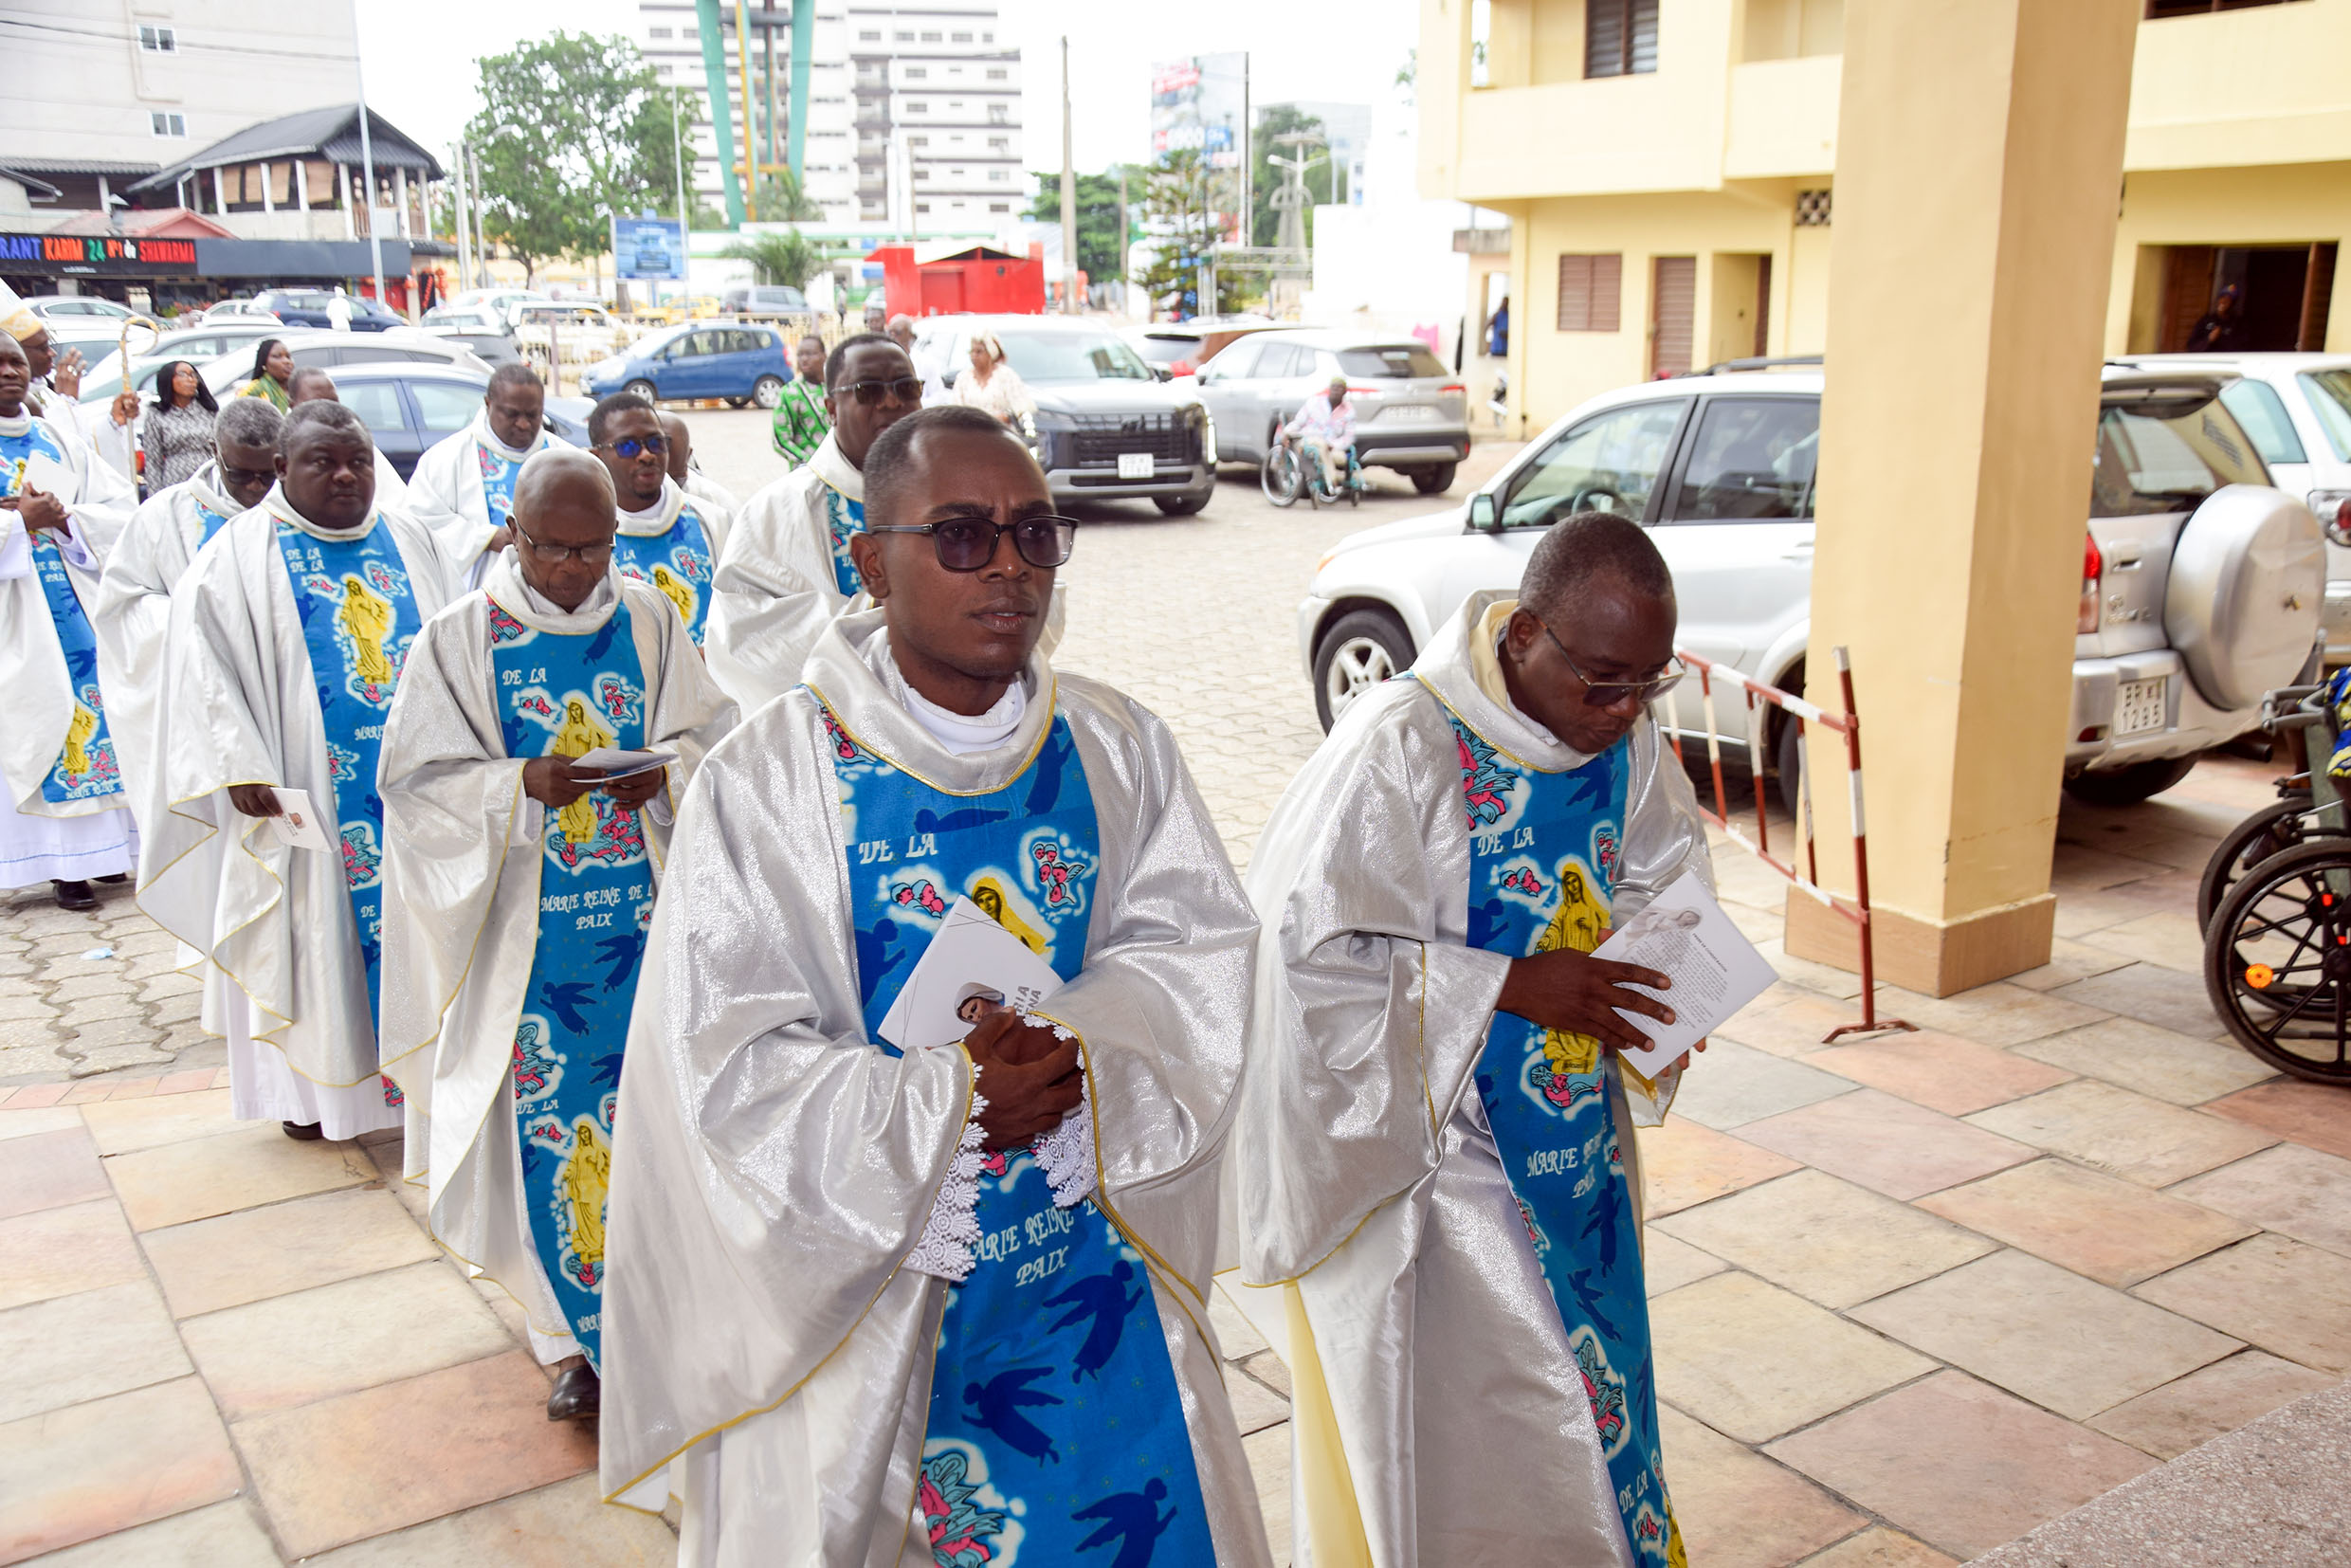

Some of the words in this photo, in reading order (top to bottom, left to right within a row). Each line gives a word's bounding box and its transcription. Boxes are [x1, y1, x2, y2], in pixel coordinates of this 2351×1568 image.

[0, 236, 41, 261] RANT
[44, 236, 84, 262] KARIM
[138, 239, 196, 264] SHAWARMA
[285, 548, 303, 560] DE
[307, 547, 322, 559] LA
[289, 560, 308, 574] DE
[310, 559, 325, 572] LA
[623, 549, 636, 561] LA
[502, 669, 522, 685] DE
[528, 667, 548, 684] LA
[905, 832, 940, 859] LA
[1477, 833, 1504, 857] DE
[1512, 826, 1536, 849] LA
[360, 904, 376, 919] DE
[540, 894, 580, 914] MARIE
[583, 886, 621, 910] REINE
[628, 884, 644, 902] DE
[575, 912, 613, 931] PAIX
[541, 1099, 559, 1112] LA
[1527, 1147, 1578, 1177] MARIE
[973, 1224, 1021, 1263] ARIE
[1025, 1204, 1075, 1248] REINE
[1015, 1245, 1070, 1287] PAIX
[1619, 1484, 1635, 1515] DE
[1636, 1469, 1649, 1499] LA
